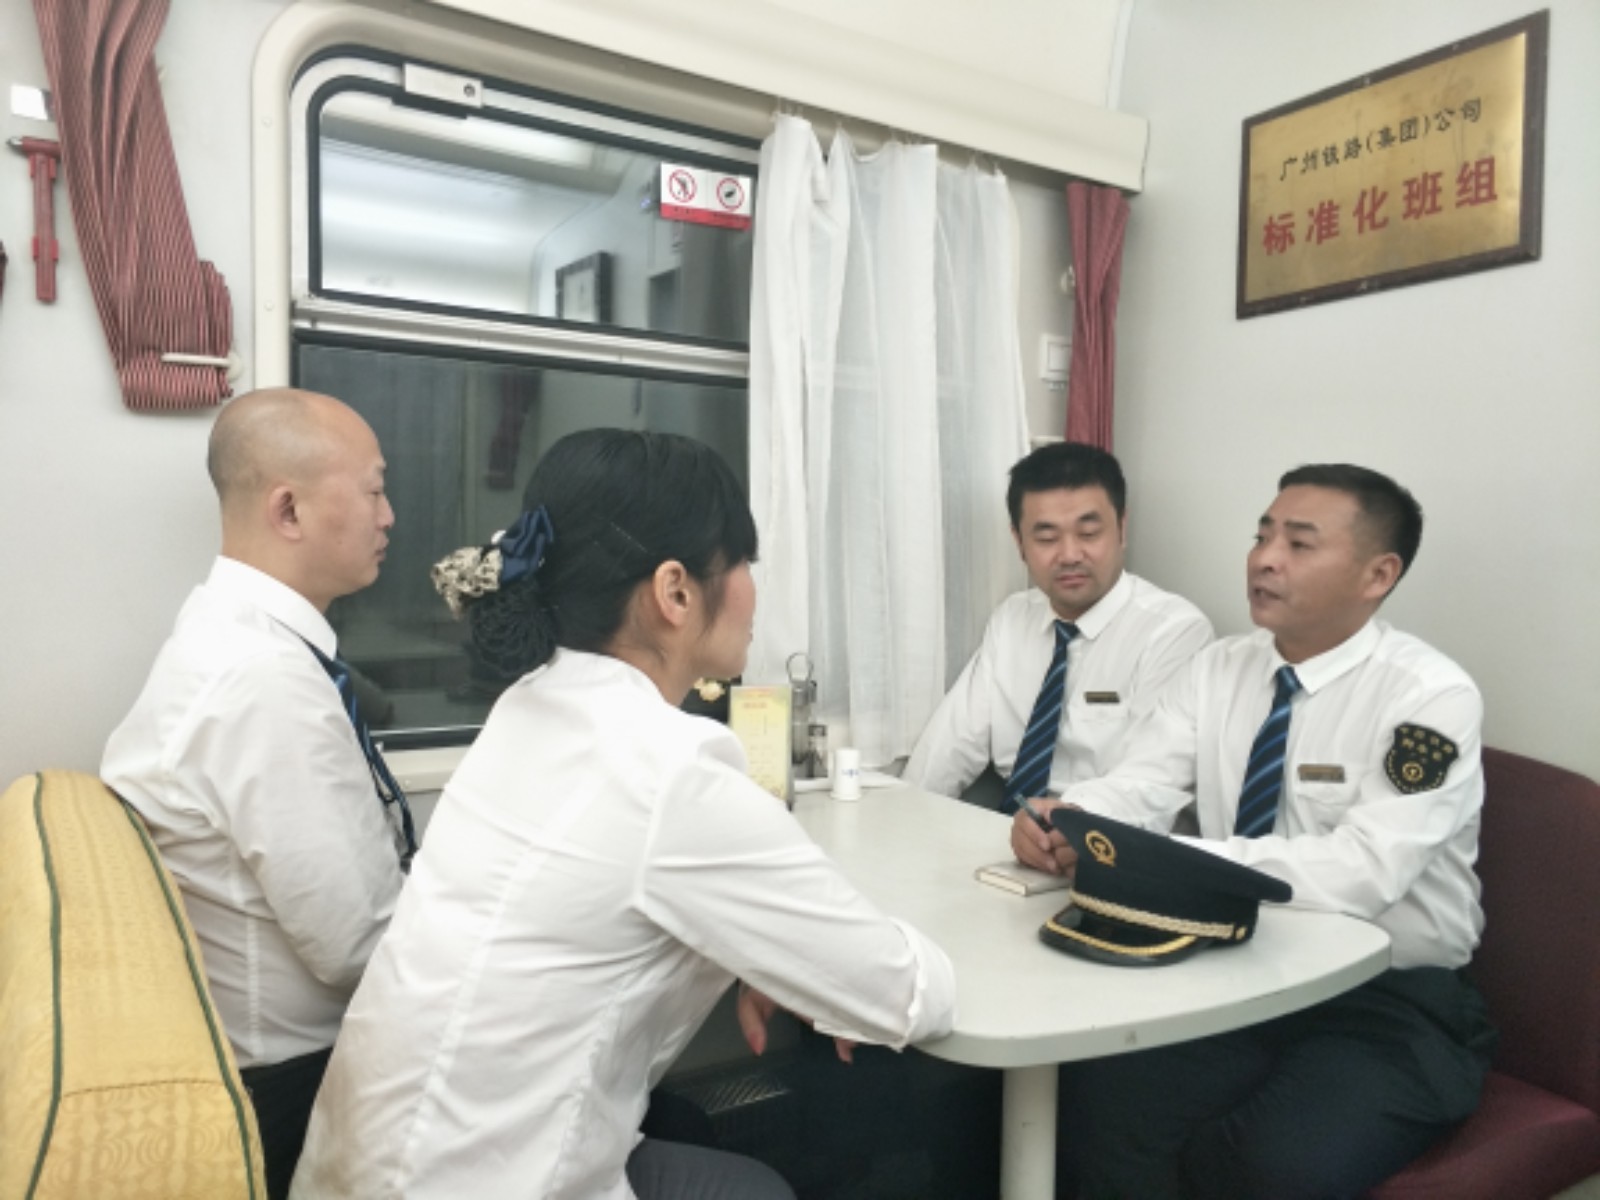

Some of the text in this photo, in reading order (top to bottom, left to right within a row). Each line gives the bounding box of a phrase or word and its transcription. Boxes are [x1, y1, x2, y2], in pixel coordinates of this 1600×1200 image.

[1262, 155, 1498, 256] 标准化班组
